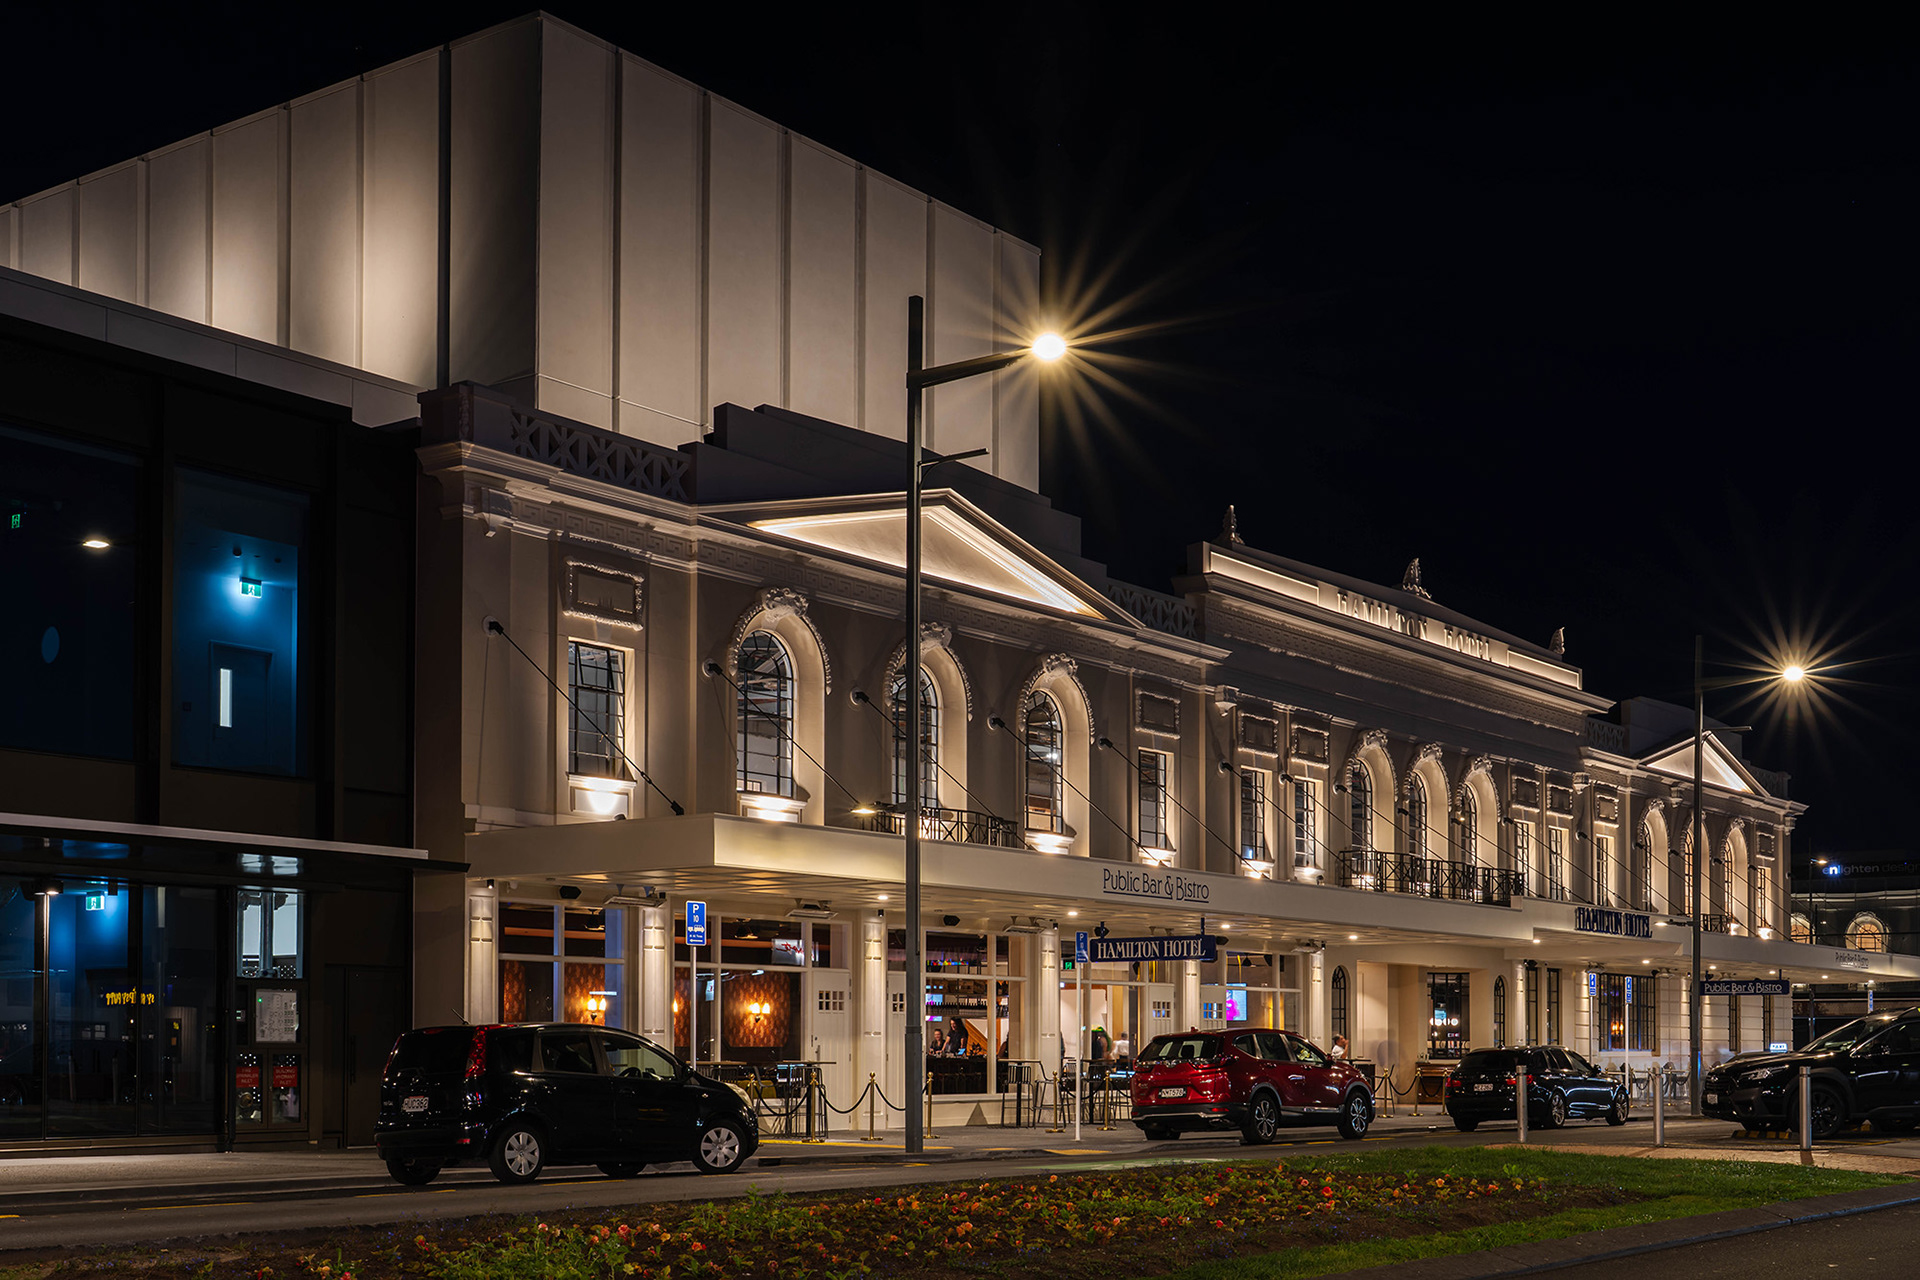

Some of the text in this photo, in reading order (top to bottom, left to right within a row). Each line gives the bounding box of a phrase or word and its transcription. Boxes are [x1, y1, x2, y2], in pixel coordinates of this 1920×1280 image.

[1337, 591, 1492, 662] HAMILTON HOTEL
[1822, 864, 1879, 876] enlighten
[1103, 868, 1210, 900] Public Bar & Bistro
[1574, 907, 1653, 938] HAMILTON HOTEL
[1097, 938, 1206, 959] HAMILTON HOTEL
[1704, 982, 1783, 993] Public Bar & Bistro
